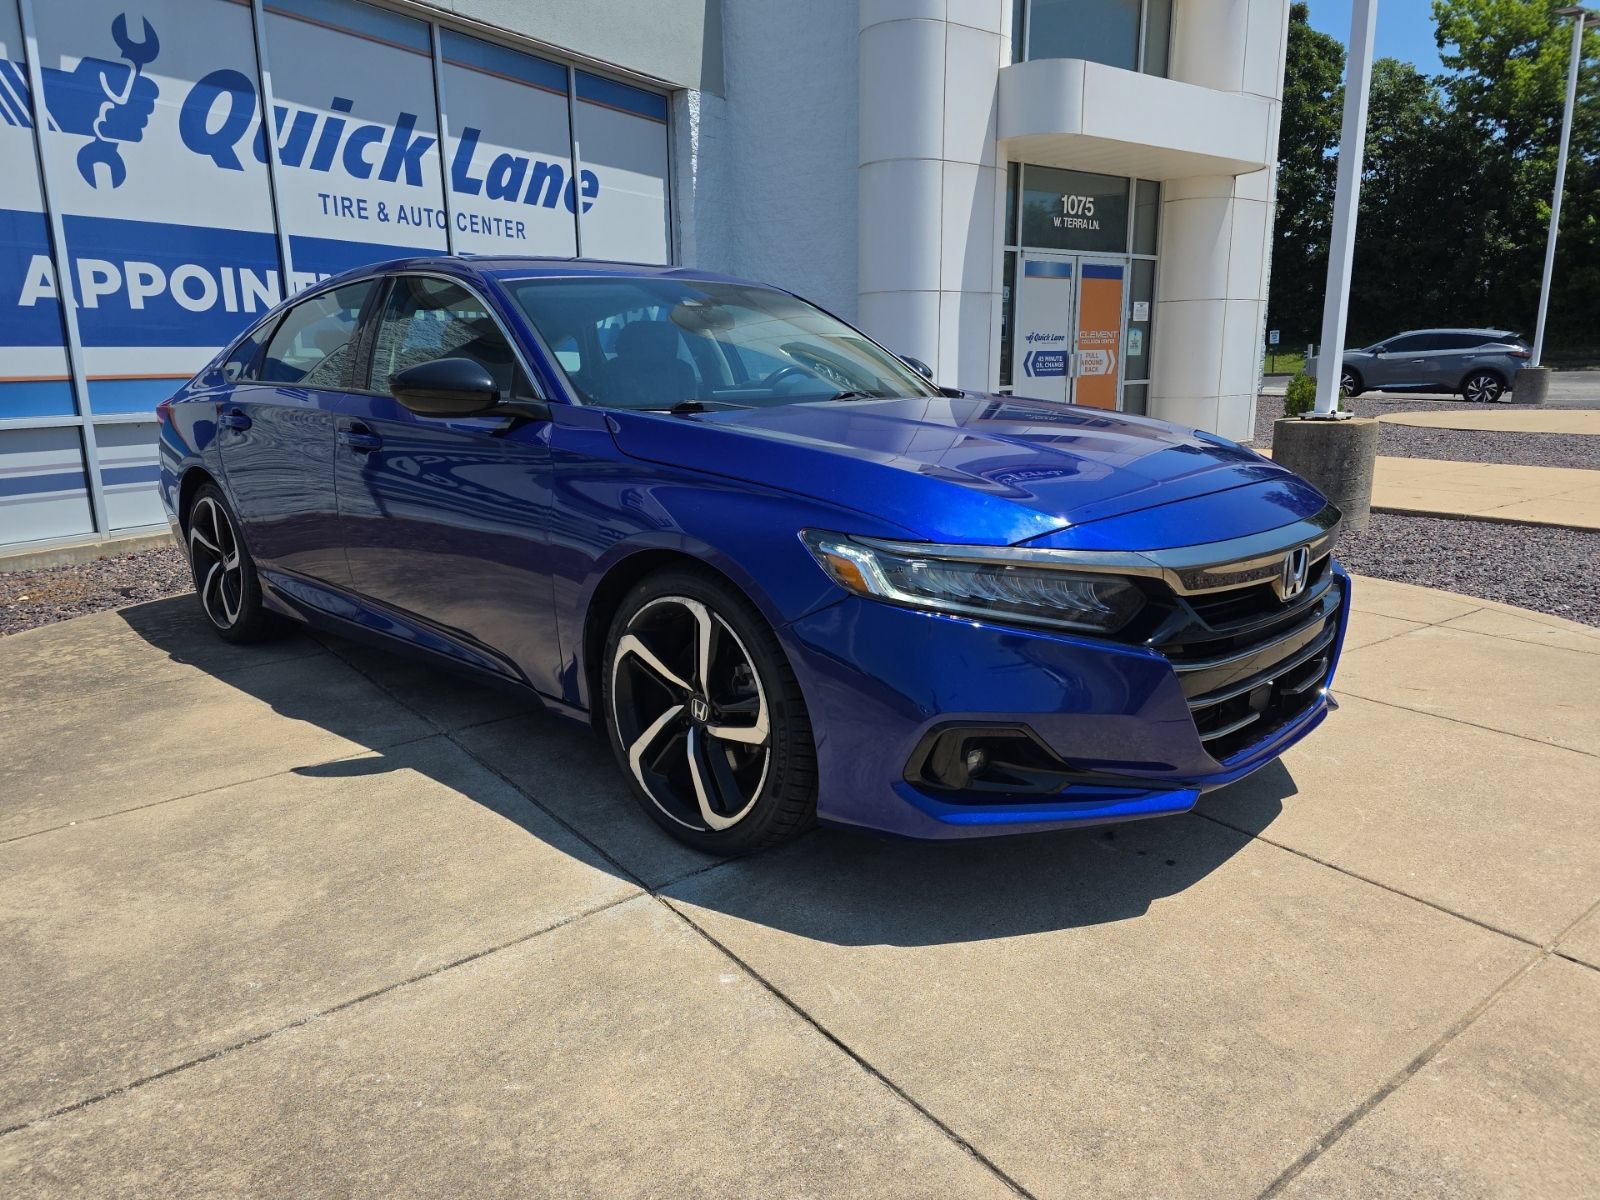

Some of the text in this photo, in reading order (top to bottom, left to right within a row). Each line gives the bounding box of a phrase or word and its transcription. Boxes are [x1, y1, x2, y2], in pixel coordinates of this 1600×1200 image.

[179, 69, 599, 215] Quick Lane
[318, 193, 526, 239] TIRE & AUTO CENTER
[1061, 195, 1094, 216] 1075
[1053, 216, 1100, 230] W. TERRA LN.
[17, 254, 332, 313] APPOINT
[1034, 333, 1050, 342] Quick
